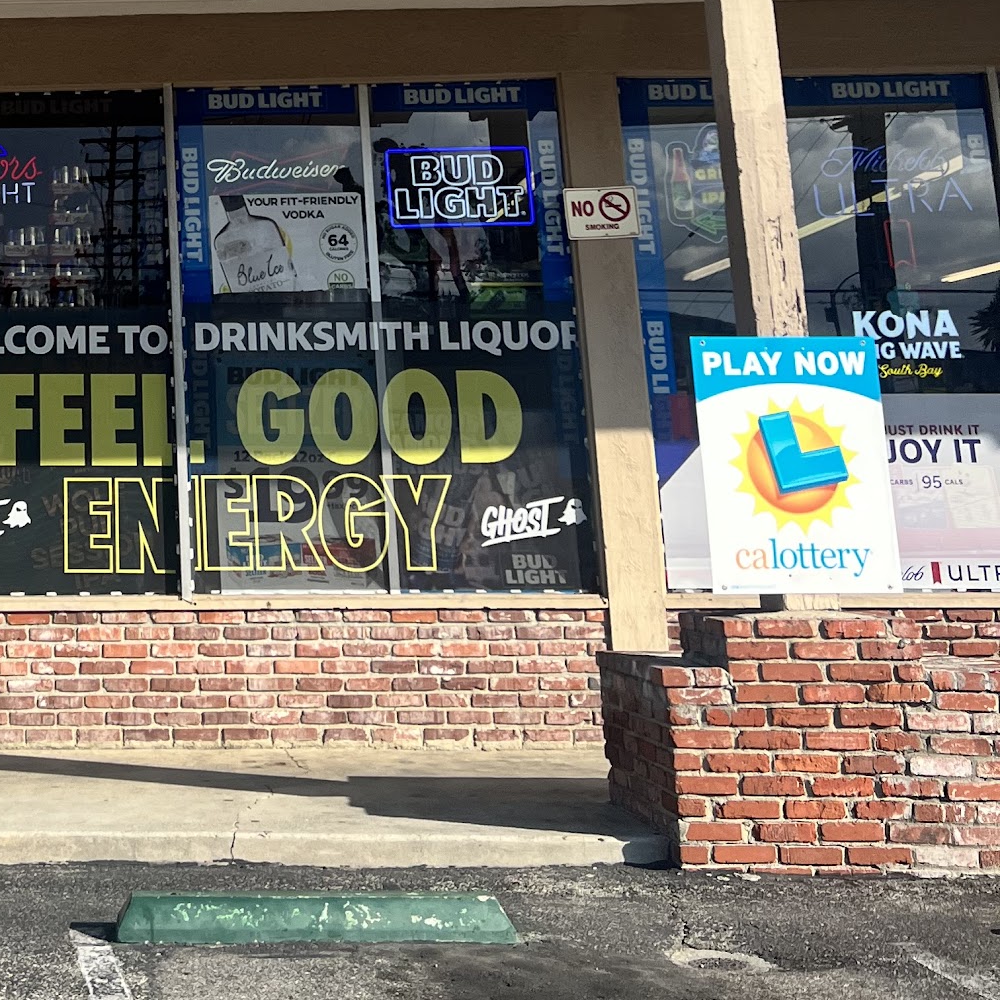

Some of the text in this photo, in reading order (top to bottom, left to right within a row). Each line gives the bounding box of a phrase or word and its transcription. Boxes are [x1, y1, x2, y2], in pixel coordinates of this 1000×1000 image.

[208, 92, 323, 109] BUD LIGHT
[404, 87, 521, 105] BUD LIGHT
[650, 85, 694, 100] BUD
[832, 80, 950, 99] BUD LIGHT
[207, 158, 344, 183] Budweiser
[410, 154, 504, 187] BUD
[821, 145, 950, 178] Michelob
[182, 148, 203, 262] BUD LIGHT
[247, 196, 359, 207] YOUR FIT-FRIENDLY
[395, 186, 524, 219] LIGHT
[537, 139, 565, 256] BUD LIGHT
[571, 200, 594, 217] NO
[627, 137, 656, 256] BUD LIGHT
[813, 177, 973, 218] ULTRA
[282, 210, 325, 219] VODKA
[585, 223, 620, 231] SMOKING
[328, 234, 349, 247] 64
[237, 264, 266, 287] Blue
[333, 273, 348, 281] NO
[852, 310, 960, 340] KONA
[118, 325, 168, 355] TO
[195, 321, 430, 352] DRINKSMITH
[646, 321, 668, 370] BUD
[875, 341, 962, 360] IG WAVE
[702, 351, 866, 376] PLAY NOW
[878, 364, 943, 378] South Bay
[236, 368, 523, 465] GOOD
[919, 424, 964, 435] DRINK
[968, 424, 980, 435] IT
[888, 438, 981, 463] JOY IT
[921, 475, 942, 489] 95
[63, 473, 452, 574] ENERGY
[481, 496, 565, 547] GHOST
[512, 554, 557, 569] BUD
[736, 539, 870, 577] calottery
[505, 569, 567, 585] LIGHT
